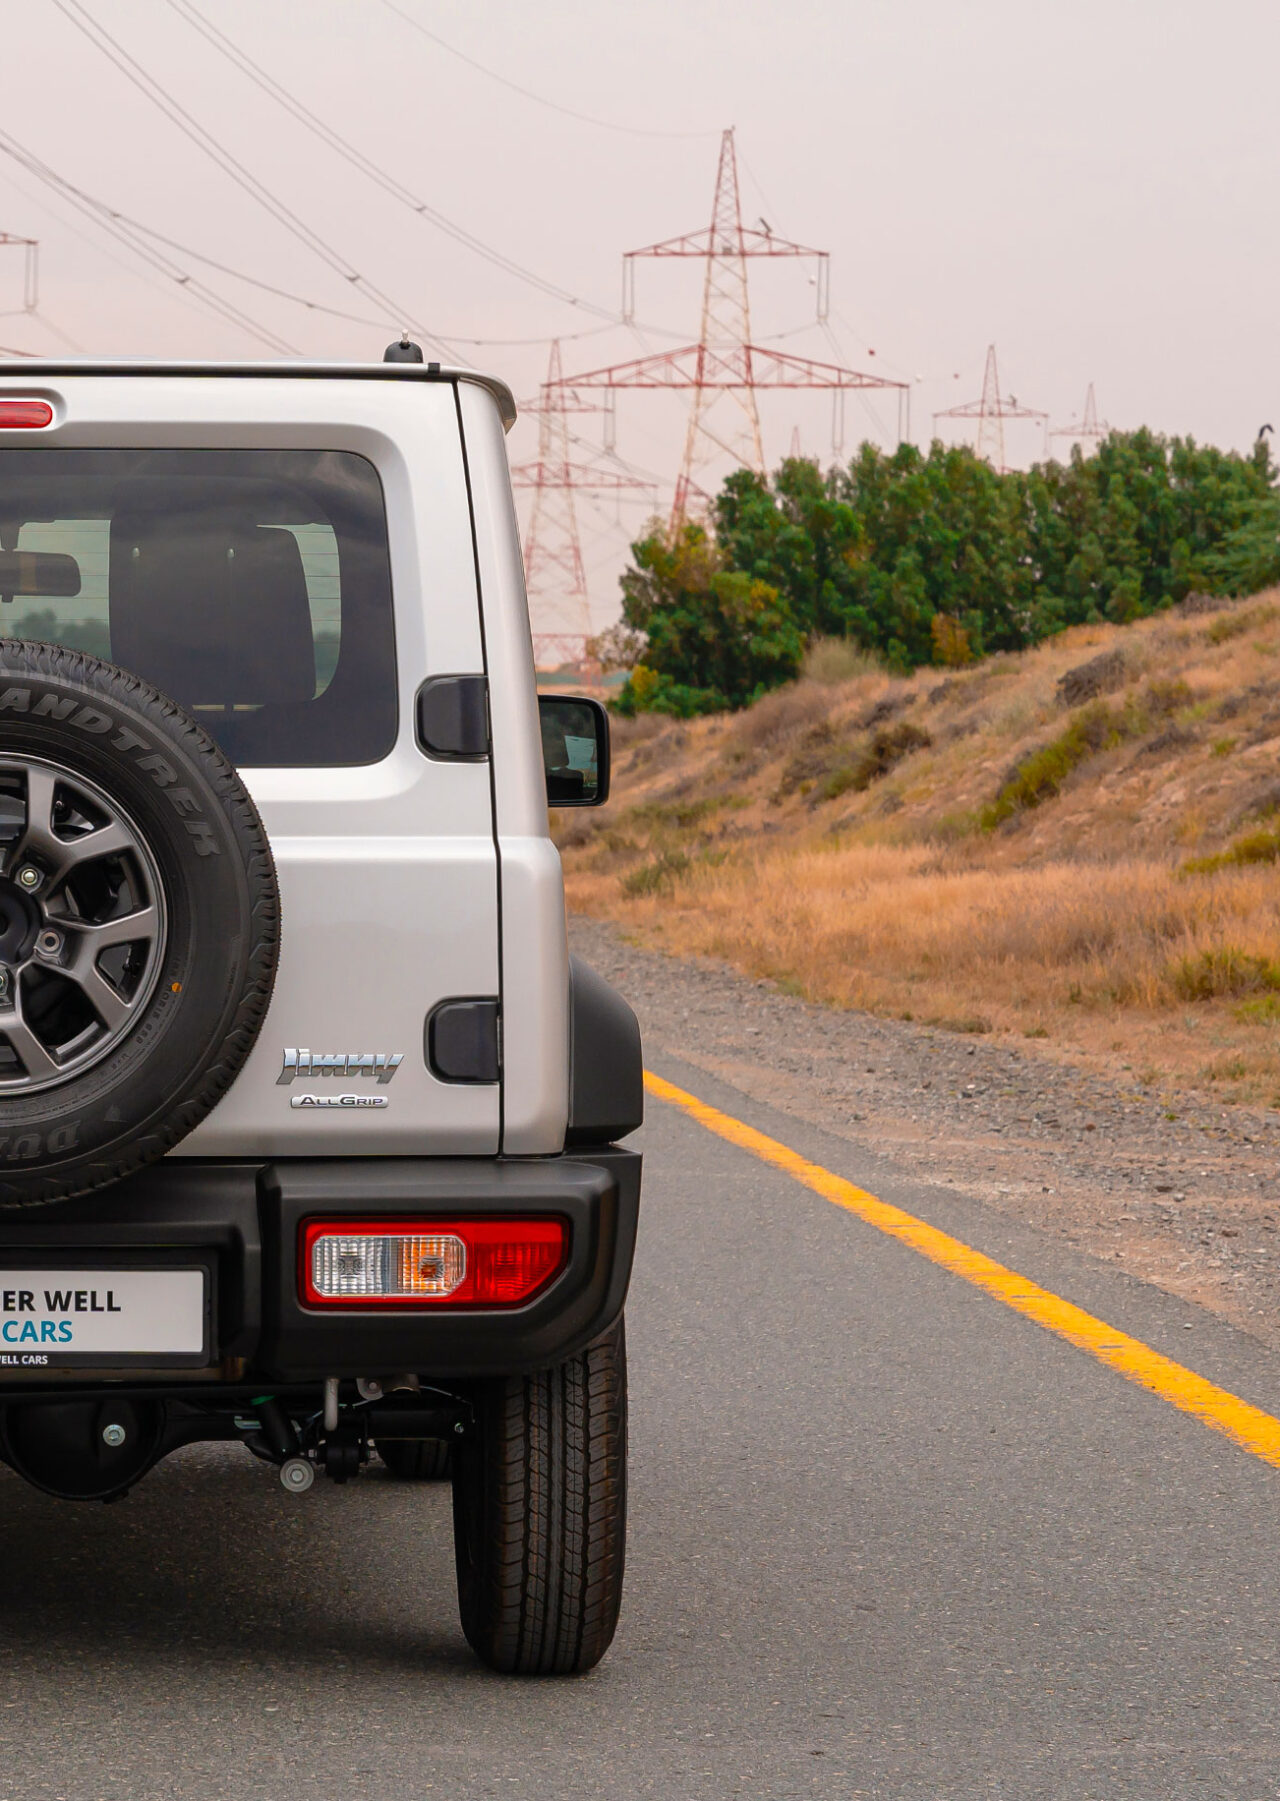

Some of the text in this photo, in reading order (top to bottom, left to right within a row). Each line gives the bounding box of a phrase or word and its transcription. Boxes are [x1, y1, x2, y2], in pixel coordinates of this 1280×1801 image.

[276, 1048, 405, 1085] Jimny
[44, 1290, 122, 1313] WELL
[2, 1320, 73, 1343] CARS
[21, 1354, 49, 1365] CARS
